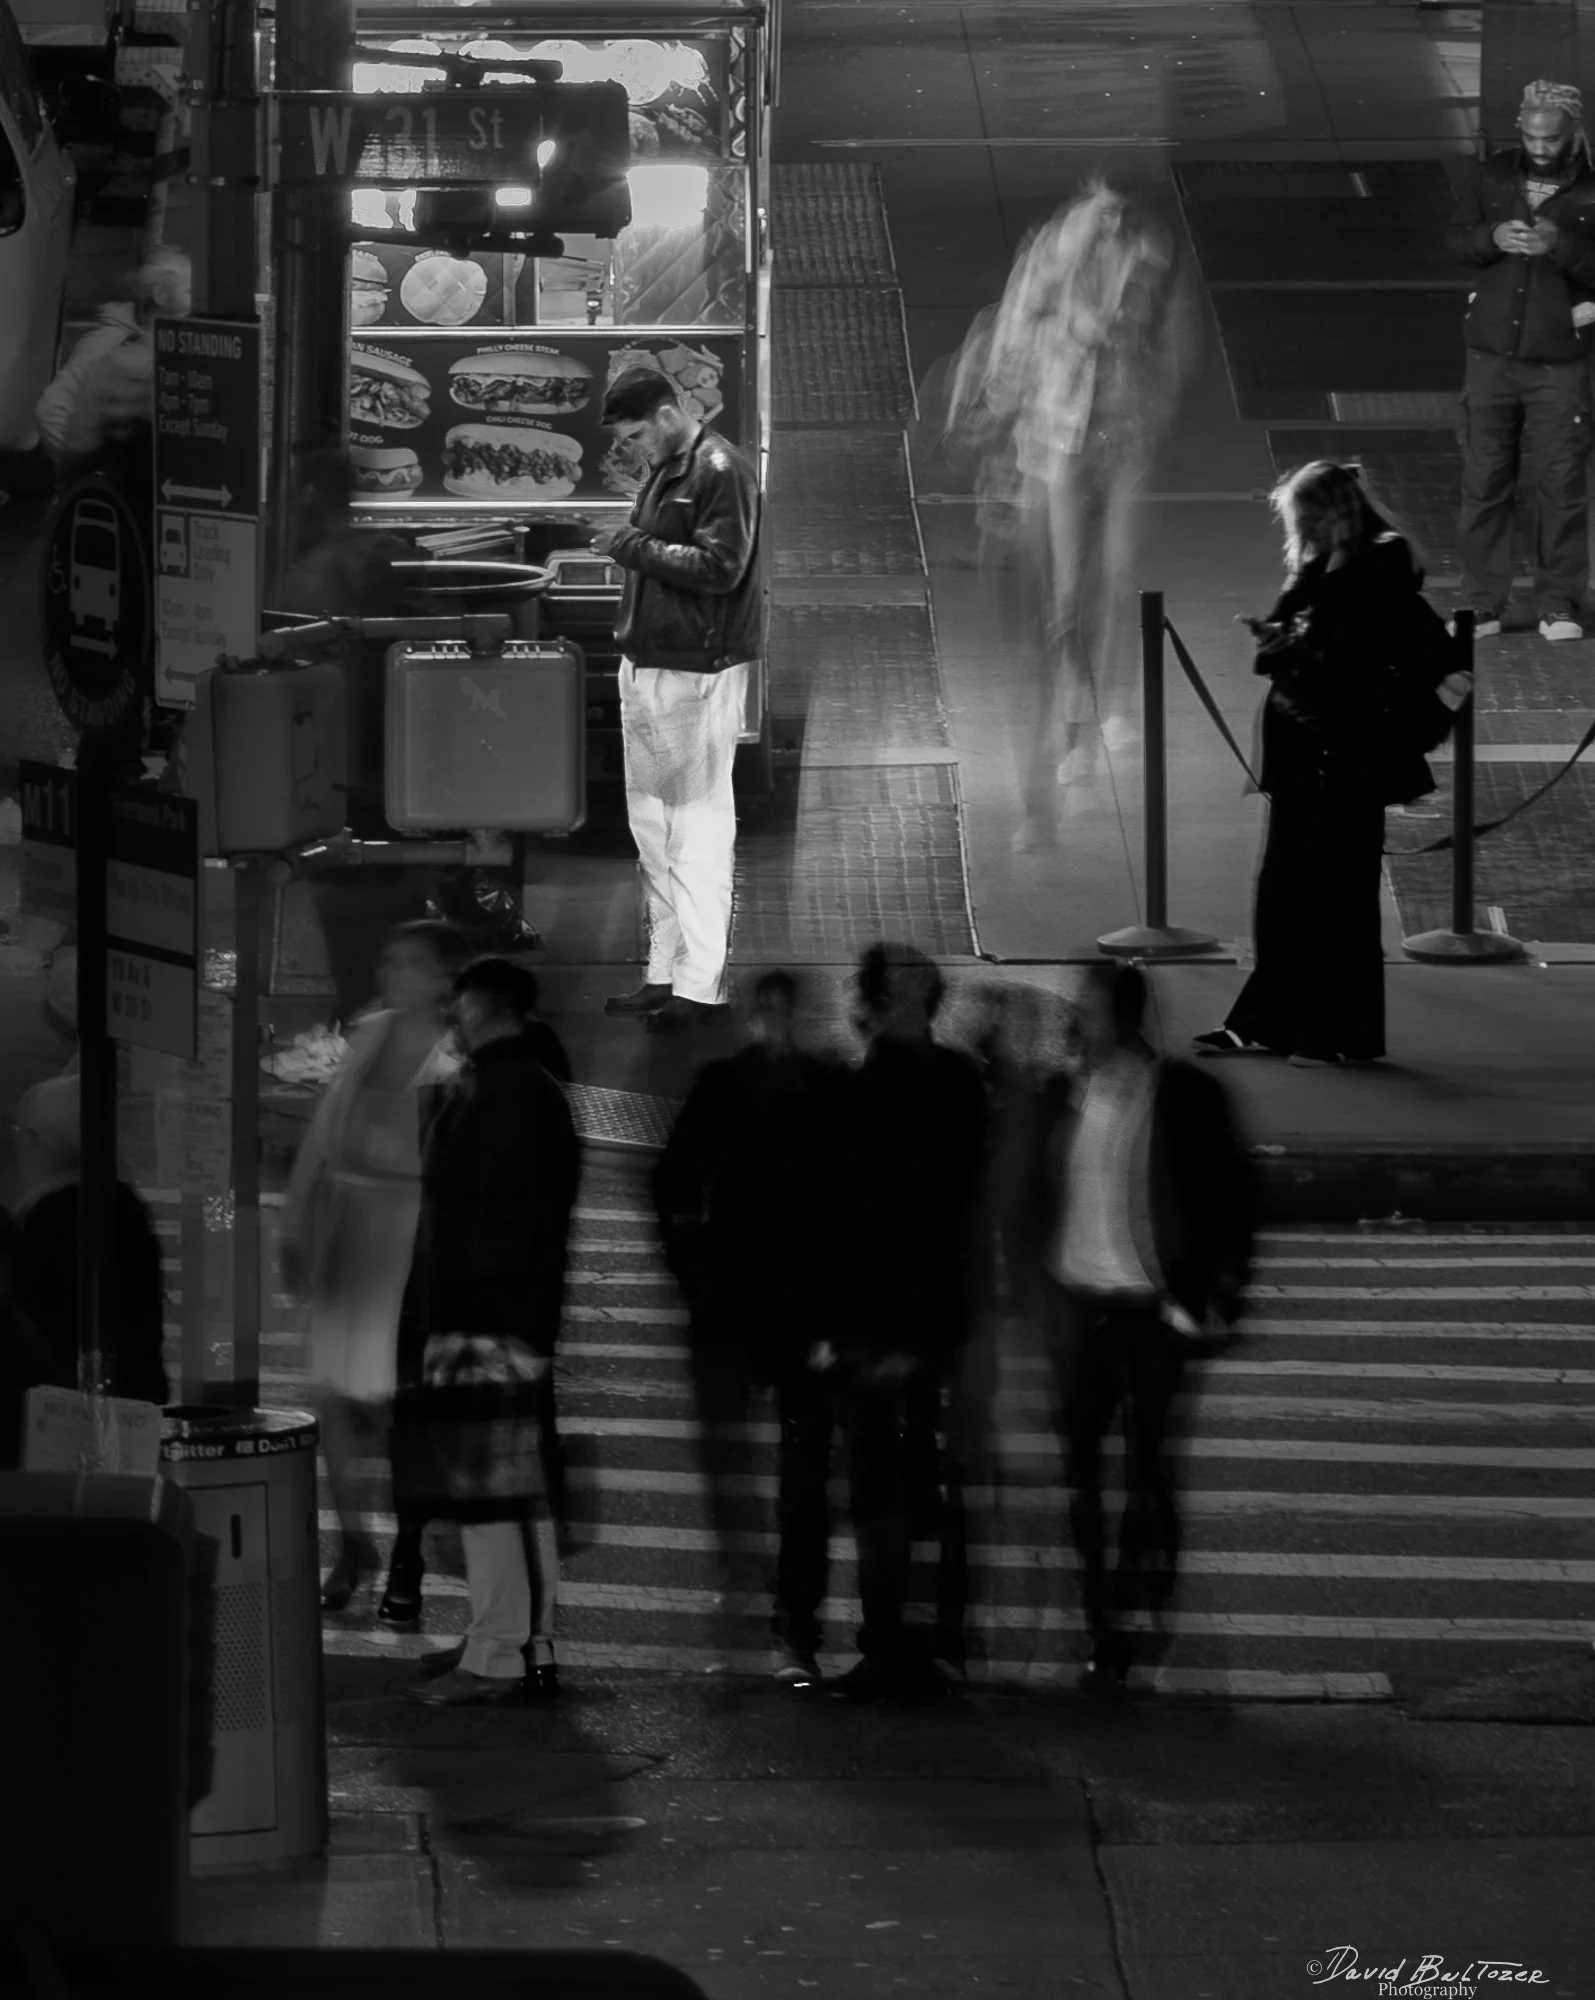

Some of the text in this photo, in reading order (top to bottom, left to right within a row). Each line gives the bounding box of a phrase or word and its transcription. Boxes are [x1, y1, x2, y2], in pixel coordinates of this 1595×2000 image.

[309, 106, 353, 175] W
[469, 106, 505, 150] St
[157, 328, 242, 360] NO STANDING
[366, 345, 414, 367] SAUSAGE
[359, 434, 384, 444] DOG
[23, 776, 71, 836] M11
